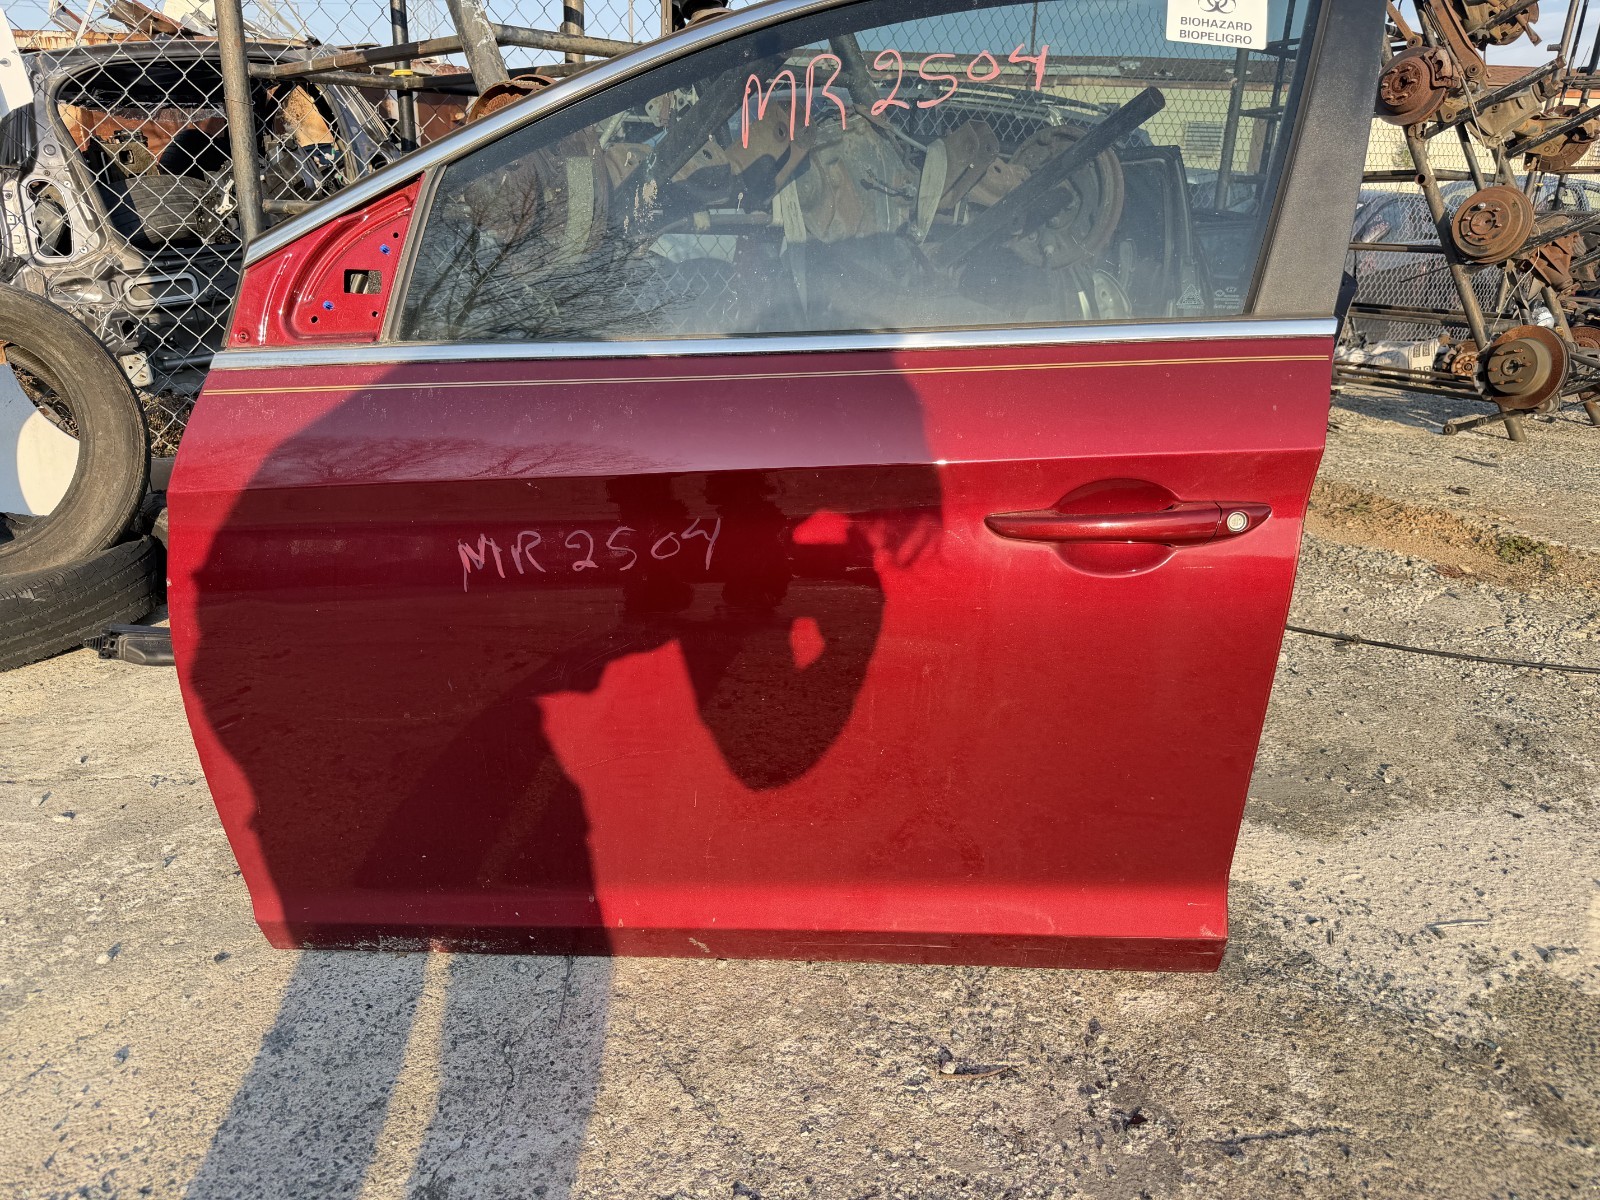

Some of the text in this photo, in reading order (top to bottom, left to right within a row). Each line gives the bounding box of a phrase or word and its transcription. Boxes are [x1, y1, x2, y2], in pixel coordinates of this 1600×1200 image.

[1179, 29, 1252, 45] BIOPELIGRO
[1180, 16, 1252, 31] BIOHAZARD
[742, 43, 1050, 149] MR 2504
[458, 517, 721, 592] MR 2504
